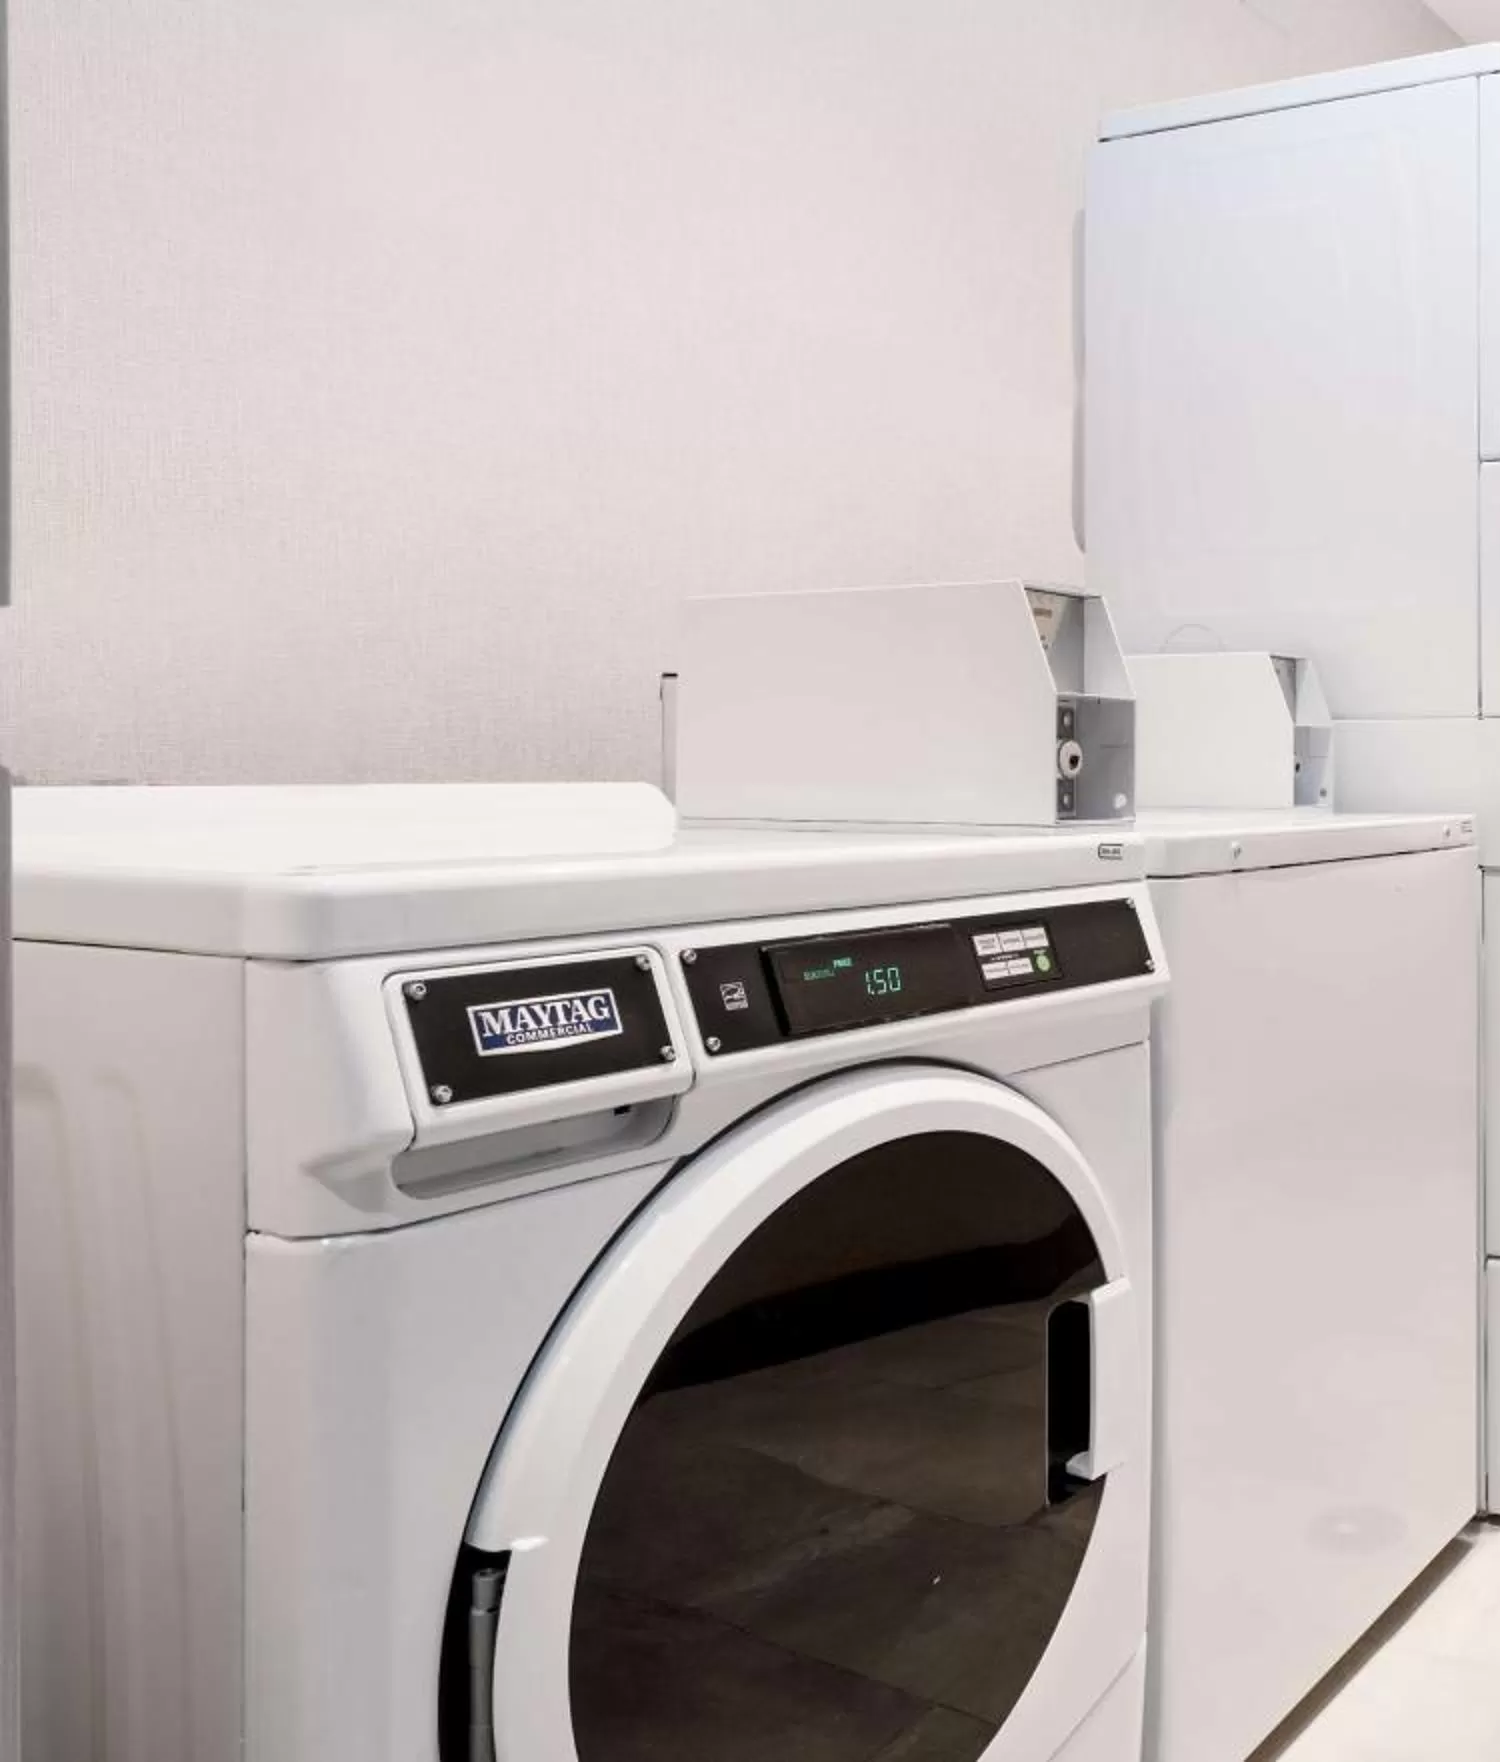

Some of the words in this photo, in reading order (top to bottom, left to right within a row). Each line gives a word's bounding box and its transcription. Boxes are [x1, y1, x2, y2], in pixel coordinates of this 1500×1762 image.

[865, 966, 902, 995] 1.50
[477, 995, 611, 1037] MAYTAG
[505, 1022, 593, 1045] COMMERCIAL
